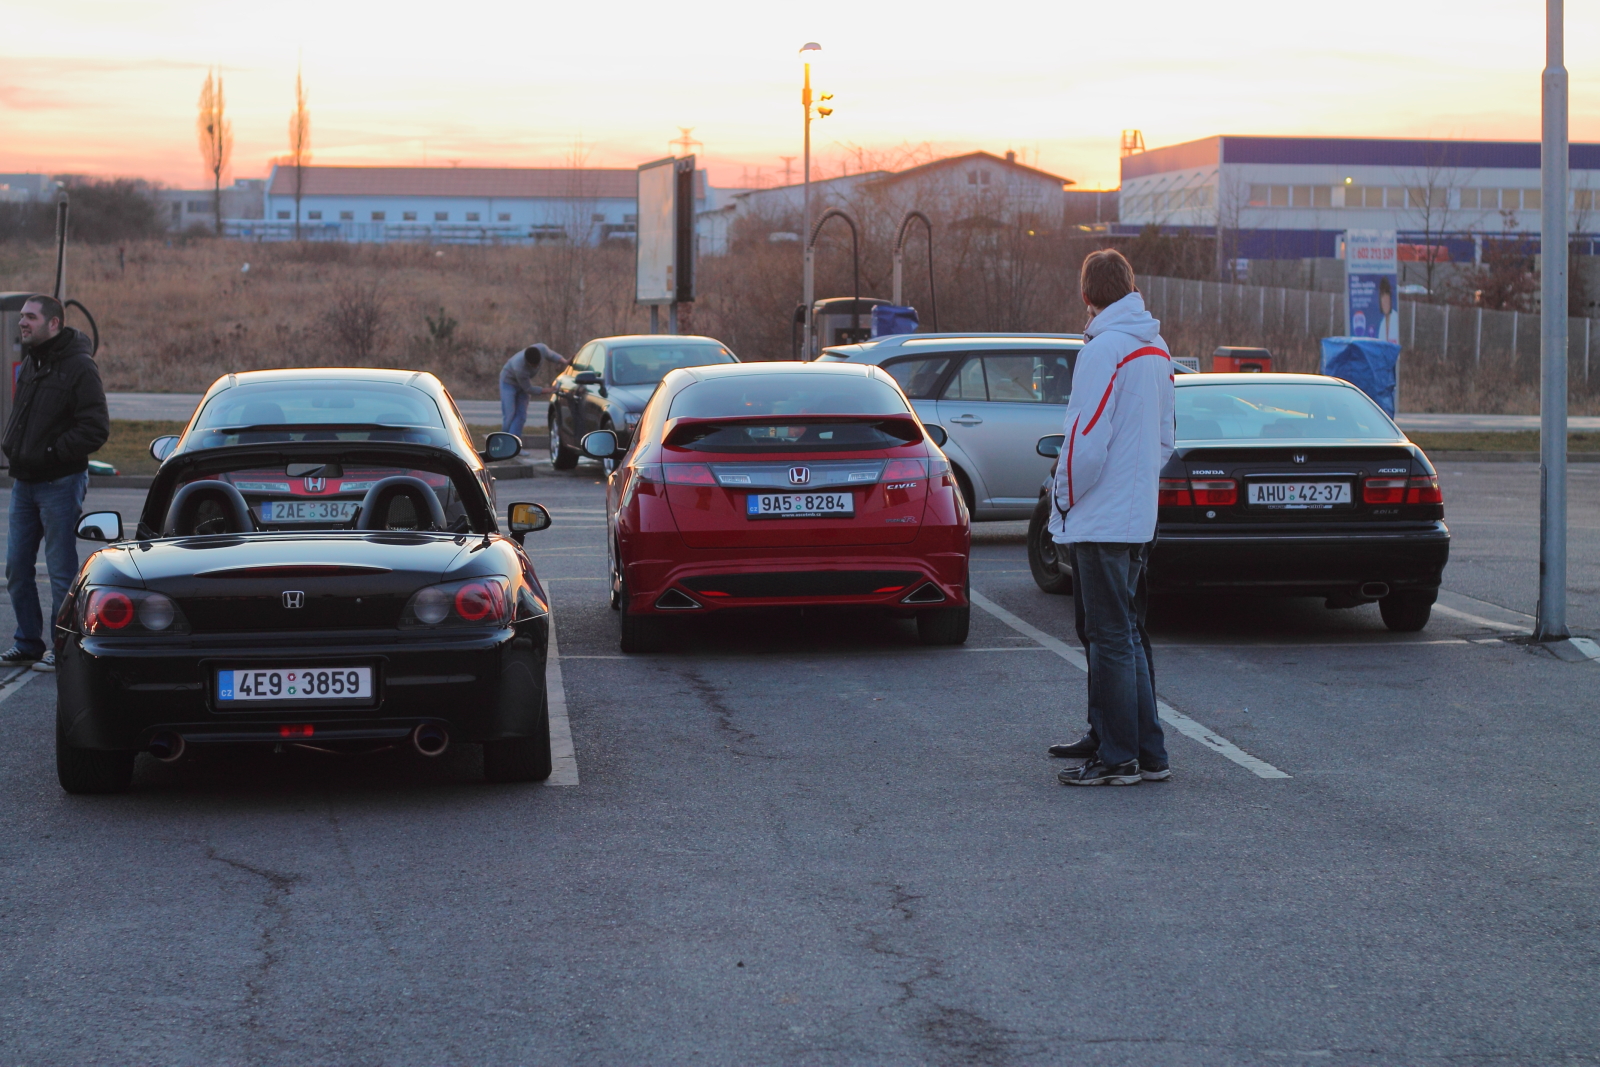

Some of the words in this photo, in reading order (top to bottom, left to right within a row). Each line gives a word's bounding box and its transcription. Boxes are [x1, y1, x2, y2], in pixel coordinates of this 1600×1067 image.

[887, 482, 917, 490] CIVIC
[1257, 485, 1286, 501] AHU
[1298, 485, 1343, 501] 42-37
[276, 503, 306, 519] 2AE
[762, 495, 792, 511] 9A5
[805, 495, 845, 510] 8284
[221, 689, 233, 697] CZ
[239, 672, 282, 697] 4E9
[302, 670, 360, 695] 3859
